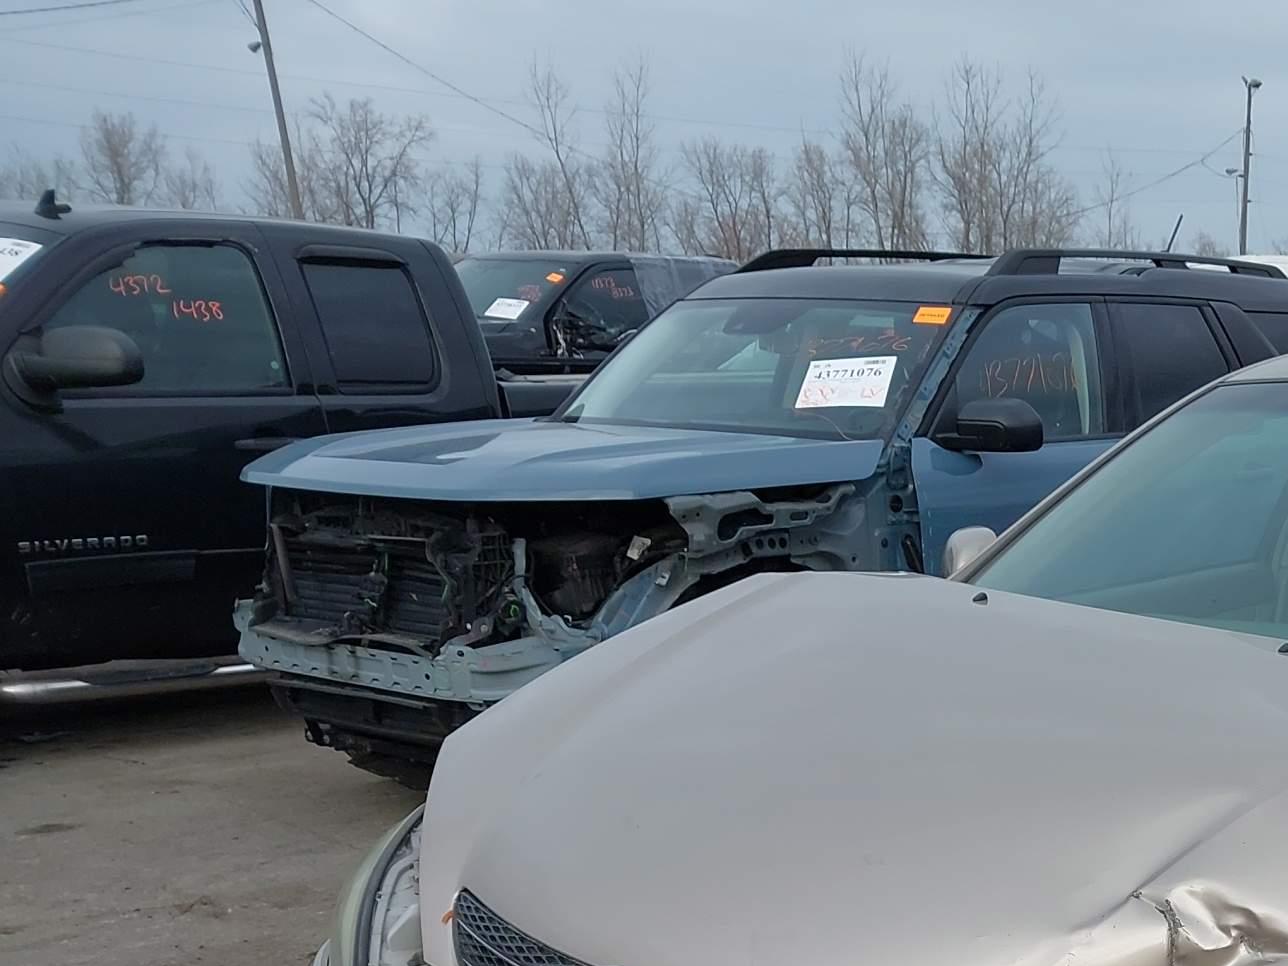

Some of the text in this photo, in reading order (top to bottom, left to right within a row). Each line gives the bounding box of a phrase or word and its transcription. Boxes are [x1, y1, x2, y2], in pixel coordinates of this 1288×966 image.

[109, 273, 172, 297] 4372
[171, 299, 224, 322] 1438
[814, 367, 882, 380] 43771076
[17, 534, 149, 553] SILVERADO
